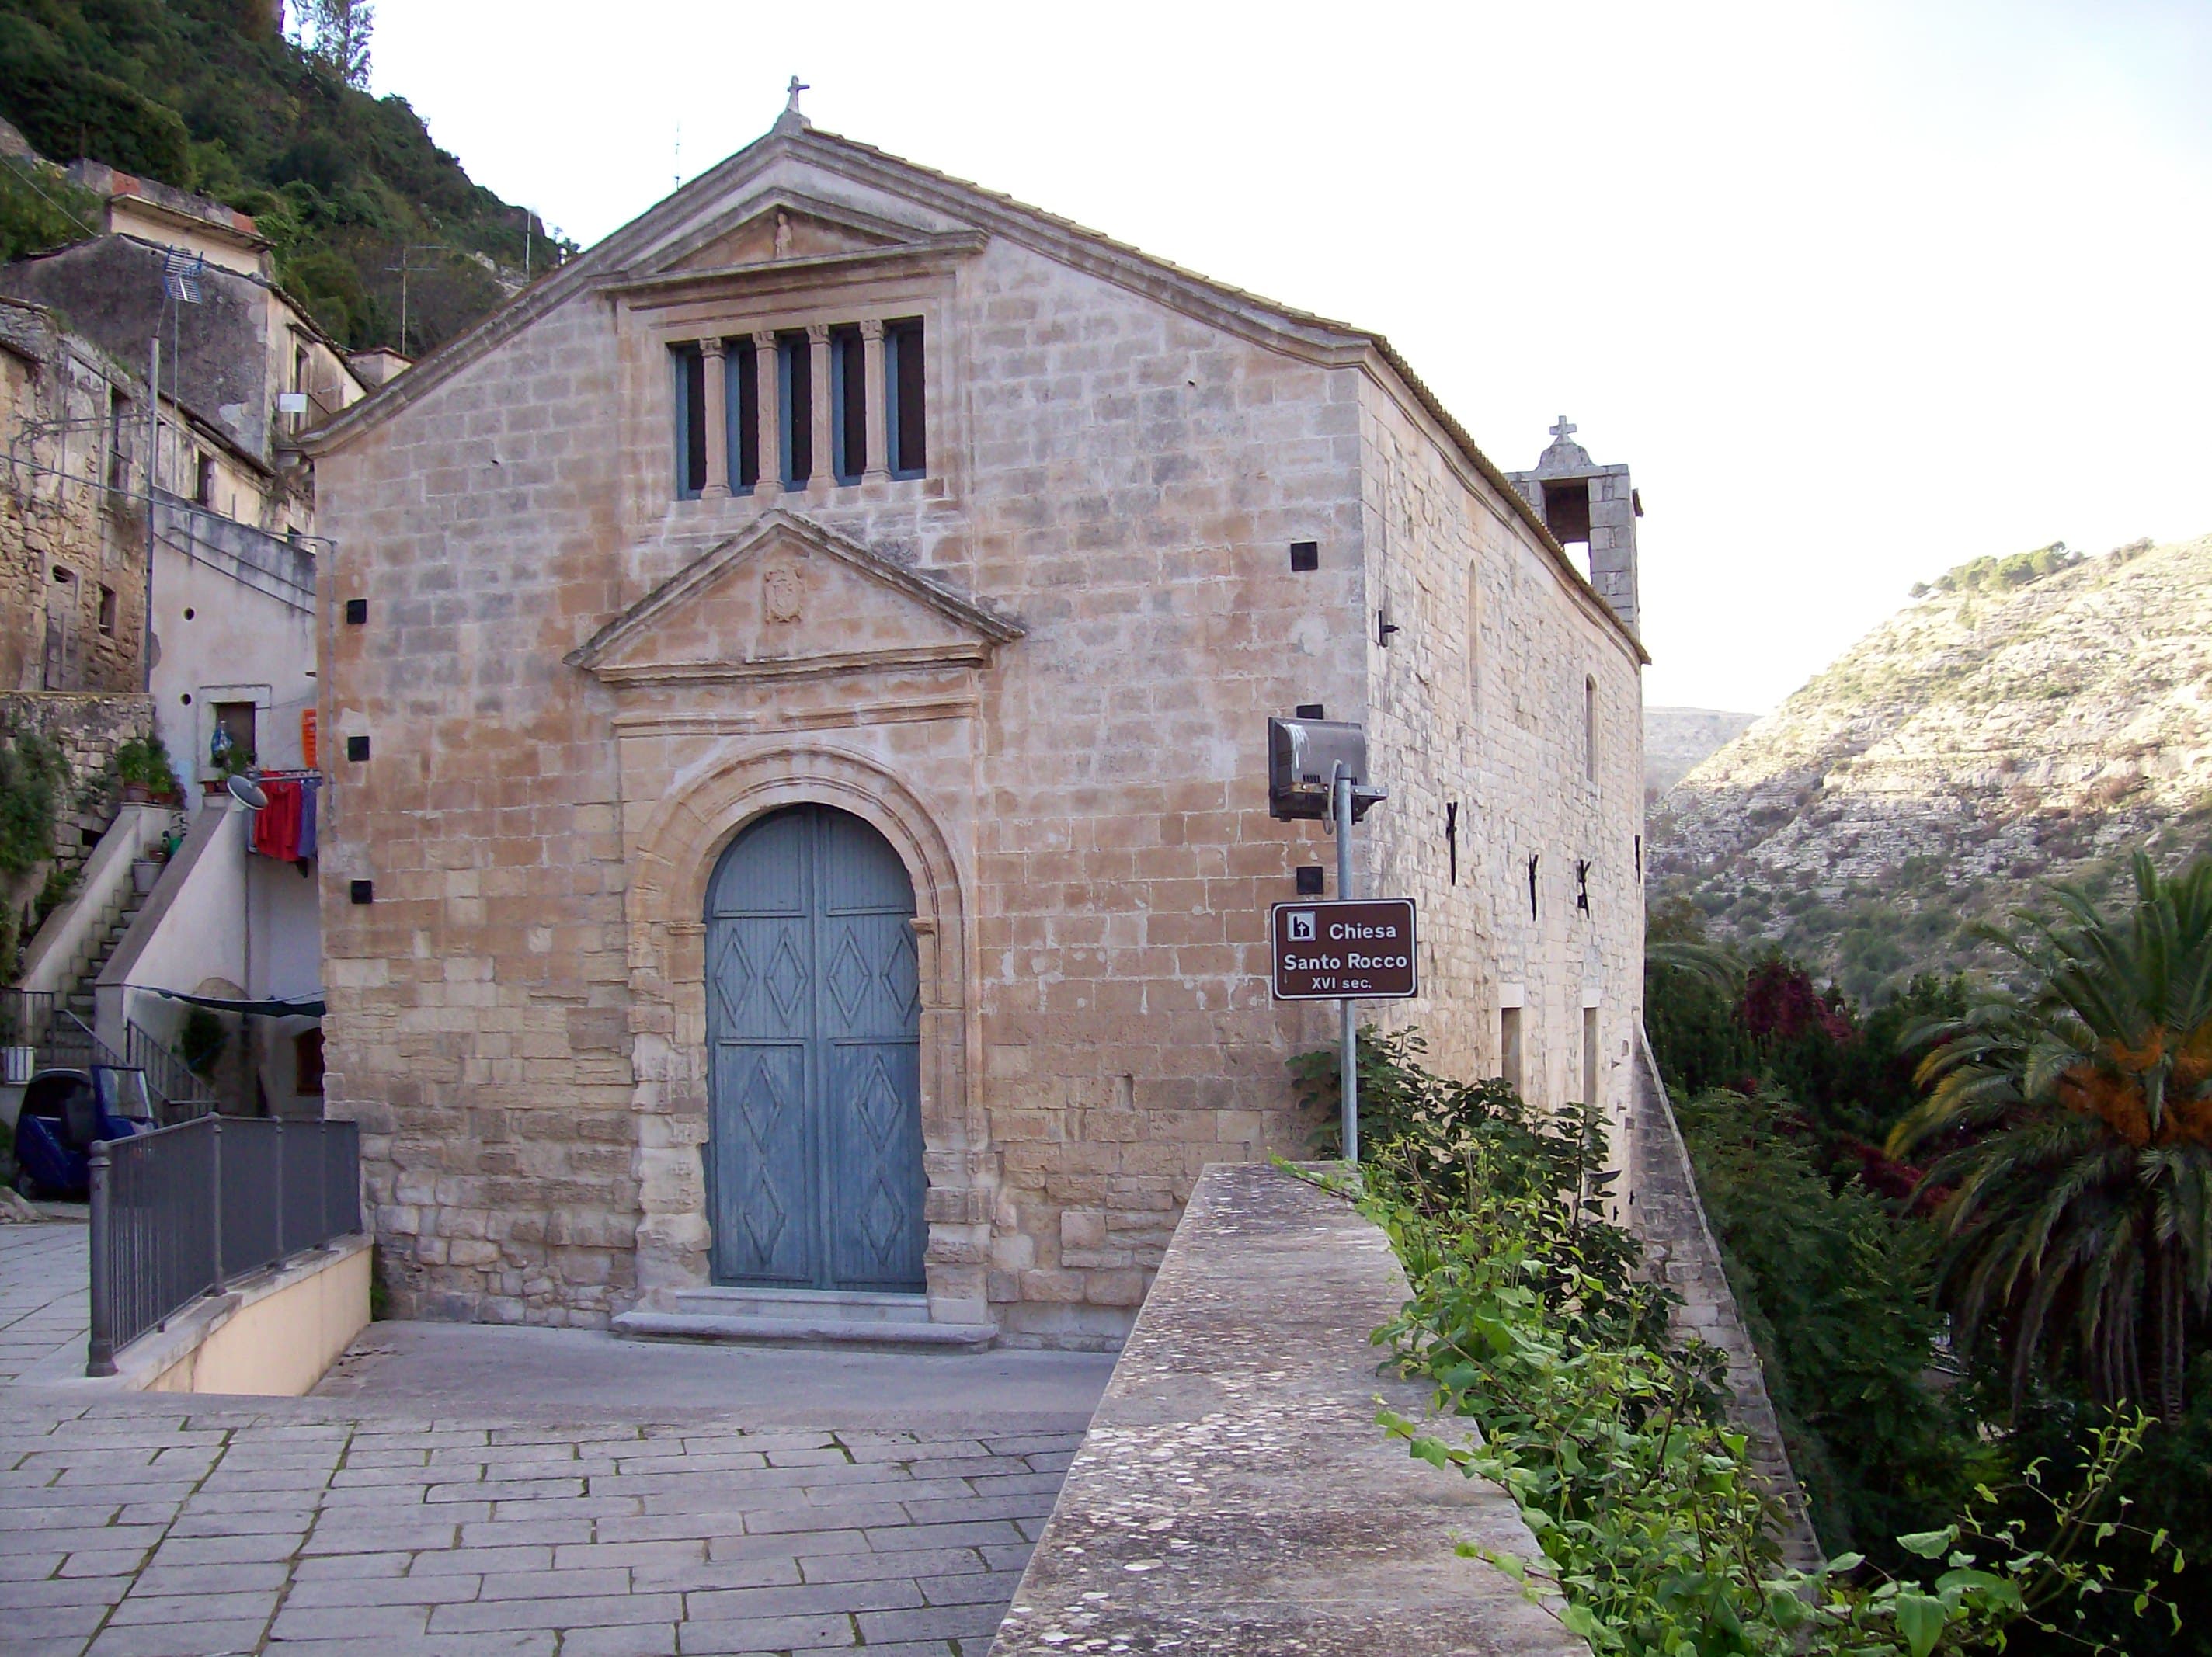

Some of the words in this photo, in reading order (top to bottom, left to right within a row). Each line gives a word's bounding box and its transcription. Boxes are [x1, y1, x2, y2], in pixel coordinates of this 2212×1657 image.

[1329, 923, 1396, 940] Chiesa
[1284, 954, 1341, 971] Santo
[1348, 953, 1407, 969] Rocco
[1312, 977, 1336, 990] XVI
[1342, 978, 1372, 988] sec.
